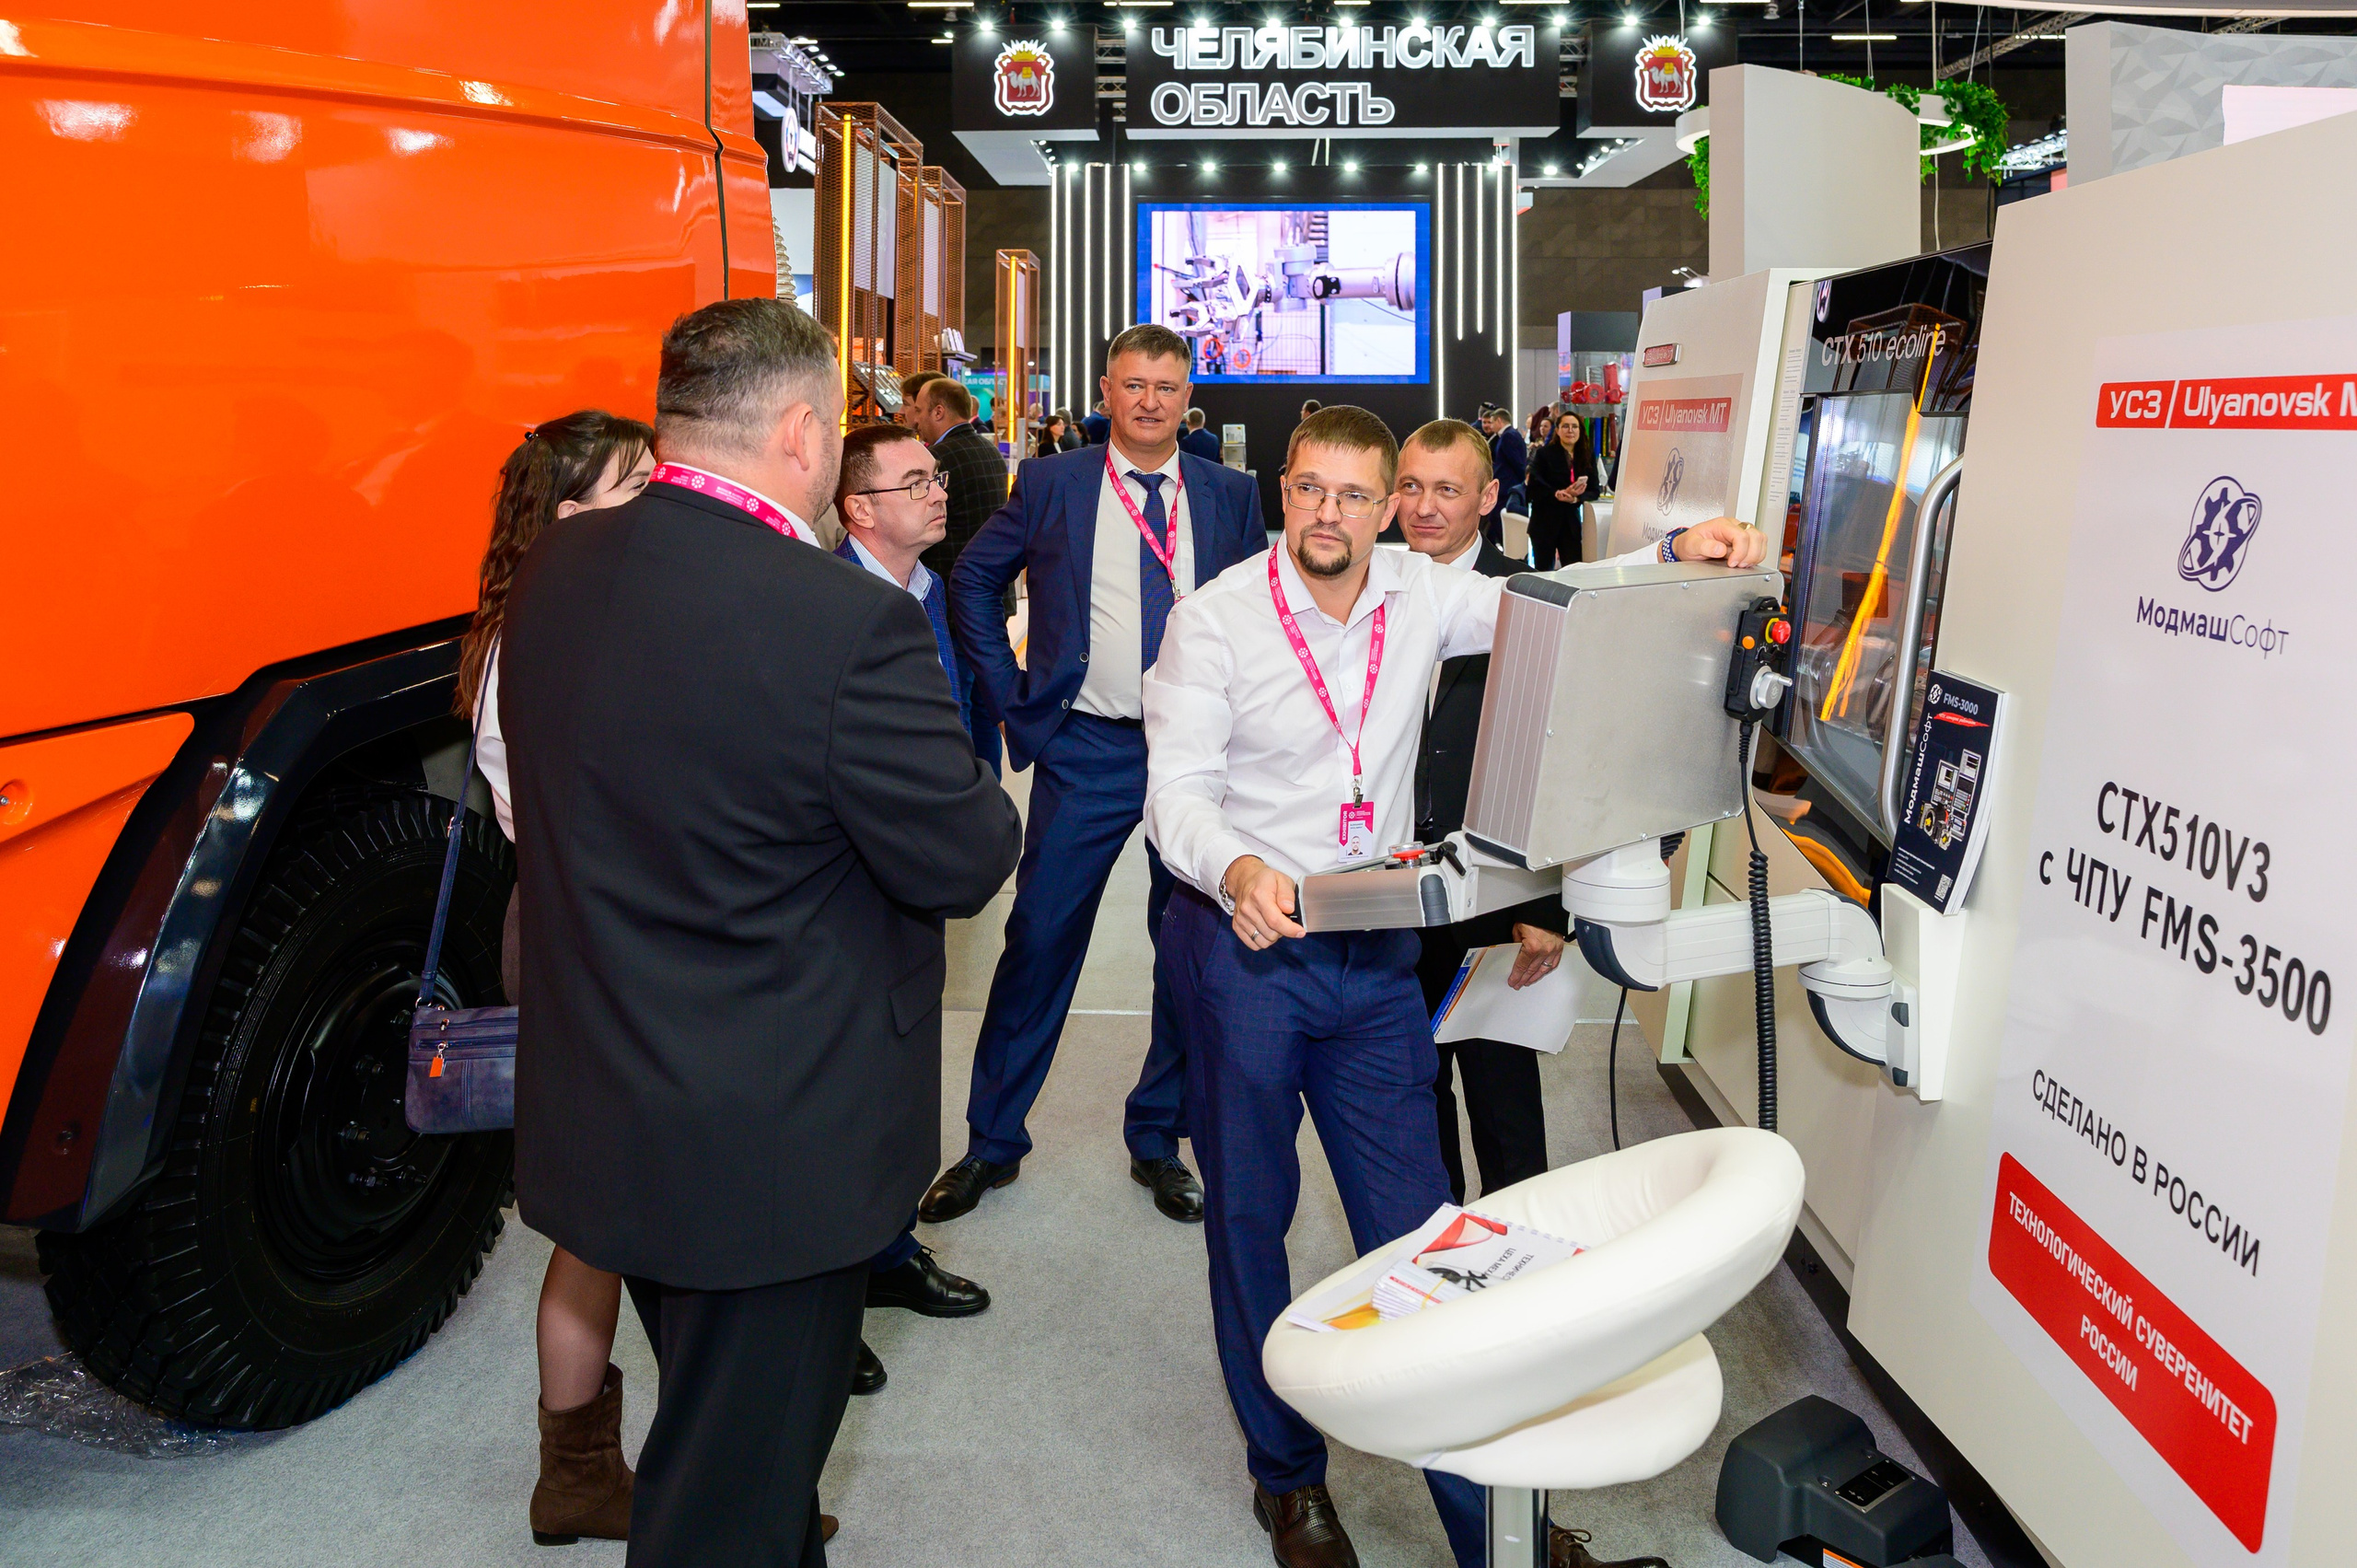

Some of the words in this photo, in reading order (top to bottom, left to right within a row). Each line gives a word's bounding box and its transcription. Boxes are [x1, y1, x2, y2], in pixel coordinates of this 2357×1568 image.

[1151, 25, 1535, 70] ЧЕЛЯБИНСКАЯ
[1150, 82, 1396, 126] ОБЛАСТЬ
[1821, 334, 1855, 366] CTX
[1856, 331, 1883, 364] 510
[1885, 324, 1946, 361] ecoline
[1665, 403, 1709, 429] Ulyanovsk
[1709, 402, 1727, 424] MT
[2183, 382, 2333, 425] Ulyanovsk
[2136, 596, 2290, 660] МодмашСофт
[1943, 692, 1979, 715] FMS-3000
[1903, 712, 1933, 824] МодмашСофт
[2097, 781, 2271, 903] CTX510V3
[2066, 846, 2132, 923] ЧПУ
[2141, 885, 2331, 1036] FMS-3500
[2033, 1069, 2127, 1167] СДЕЛАНО
[2131, 1144, 2147, 1185] В
[2154, 1162, 2260, 1277] РОССИИ
[2009, 1191, 2134, 1331] ТЕХНОЛОГИЧЕСКИЙ
[2135, 1315, 2254, 1446] СУВЕРЕНИТЕТ
[2080, 1314, 2139, 1392] РОССИИ
